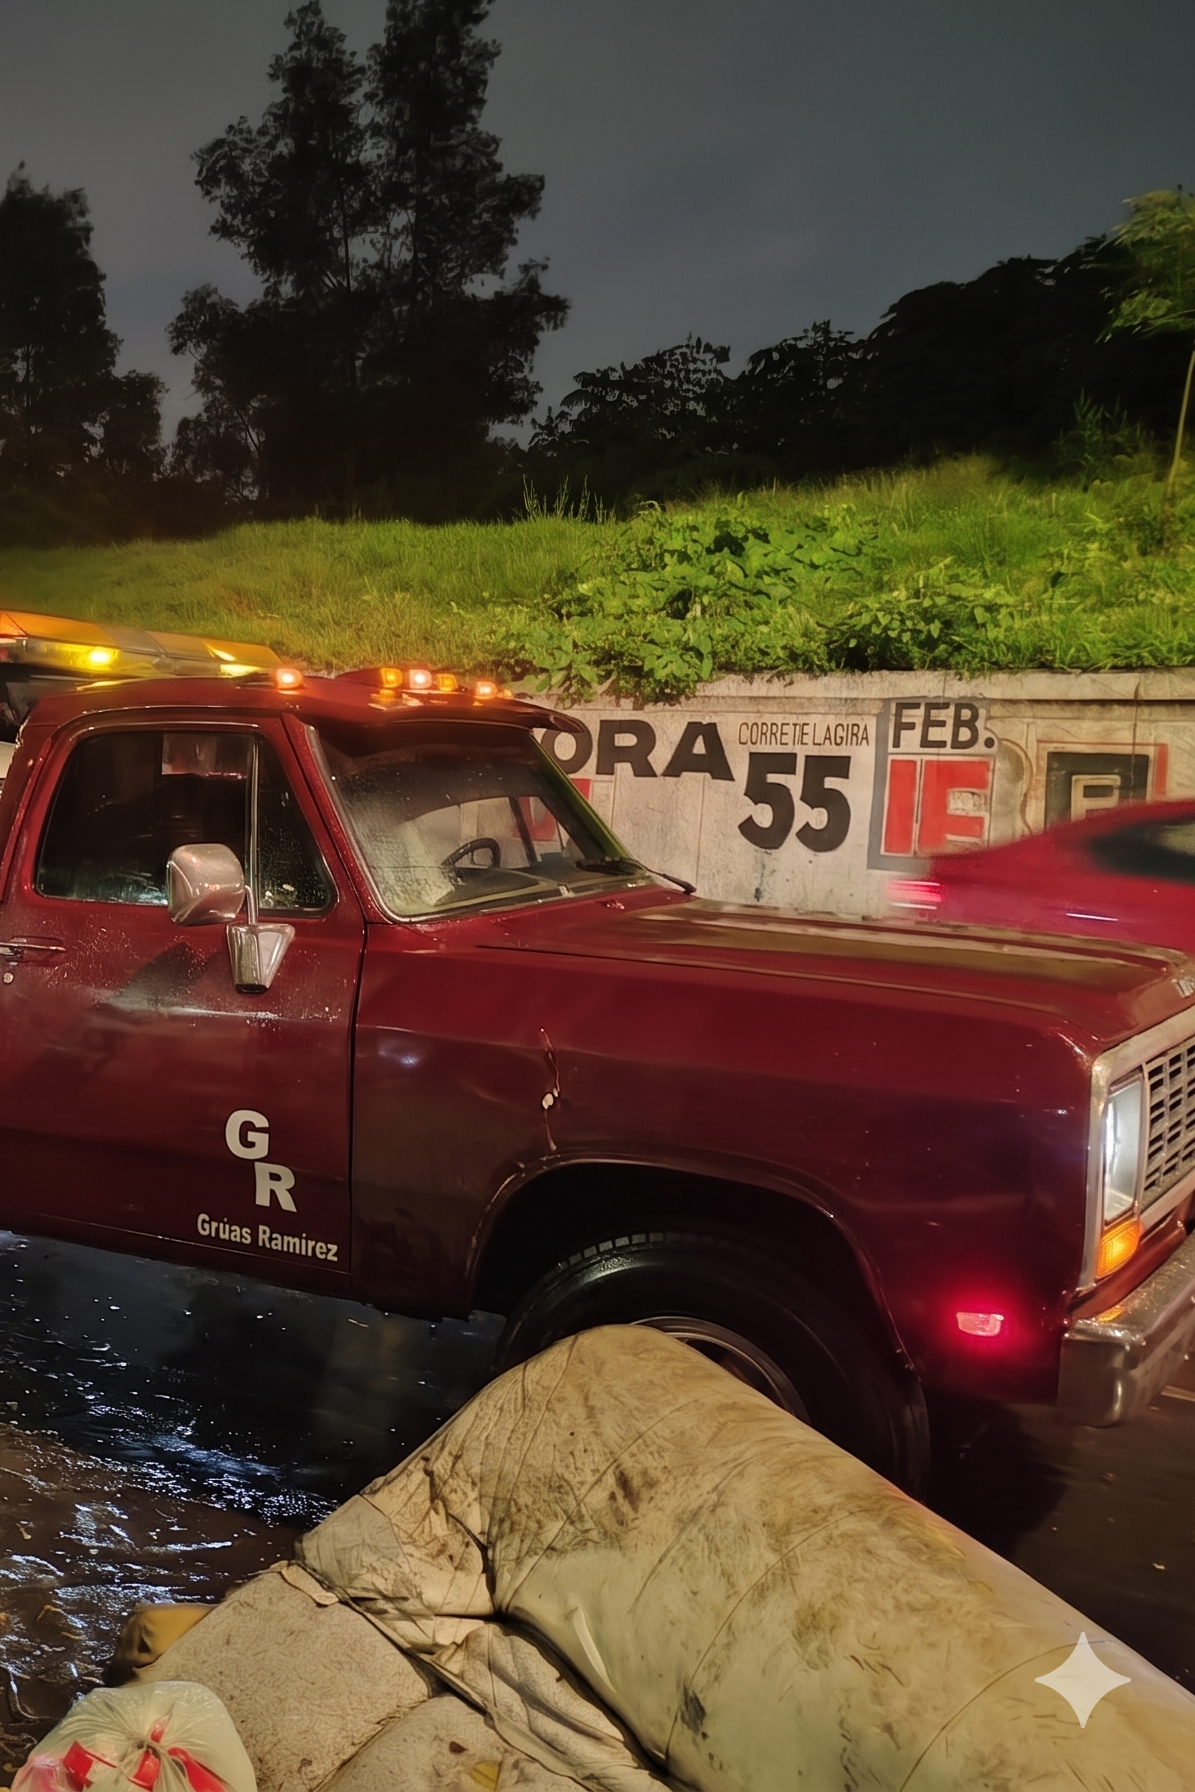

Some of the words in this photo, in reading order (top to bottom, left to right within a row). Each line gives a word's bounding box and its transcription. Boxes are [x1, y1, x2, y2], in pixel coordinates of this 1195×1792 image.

[892, 702, 995, 749] FEB.
[737, 751, 852, 853] 55
[225, 1109, 270, 1160] G
[254, 1161, 298, 1213] R
[197, 1213, 252, 1245] Grúas
